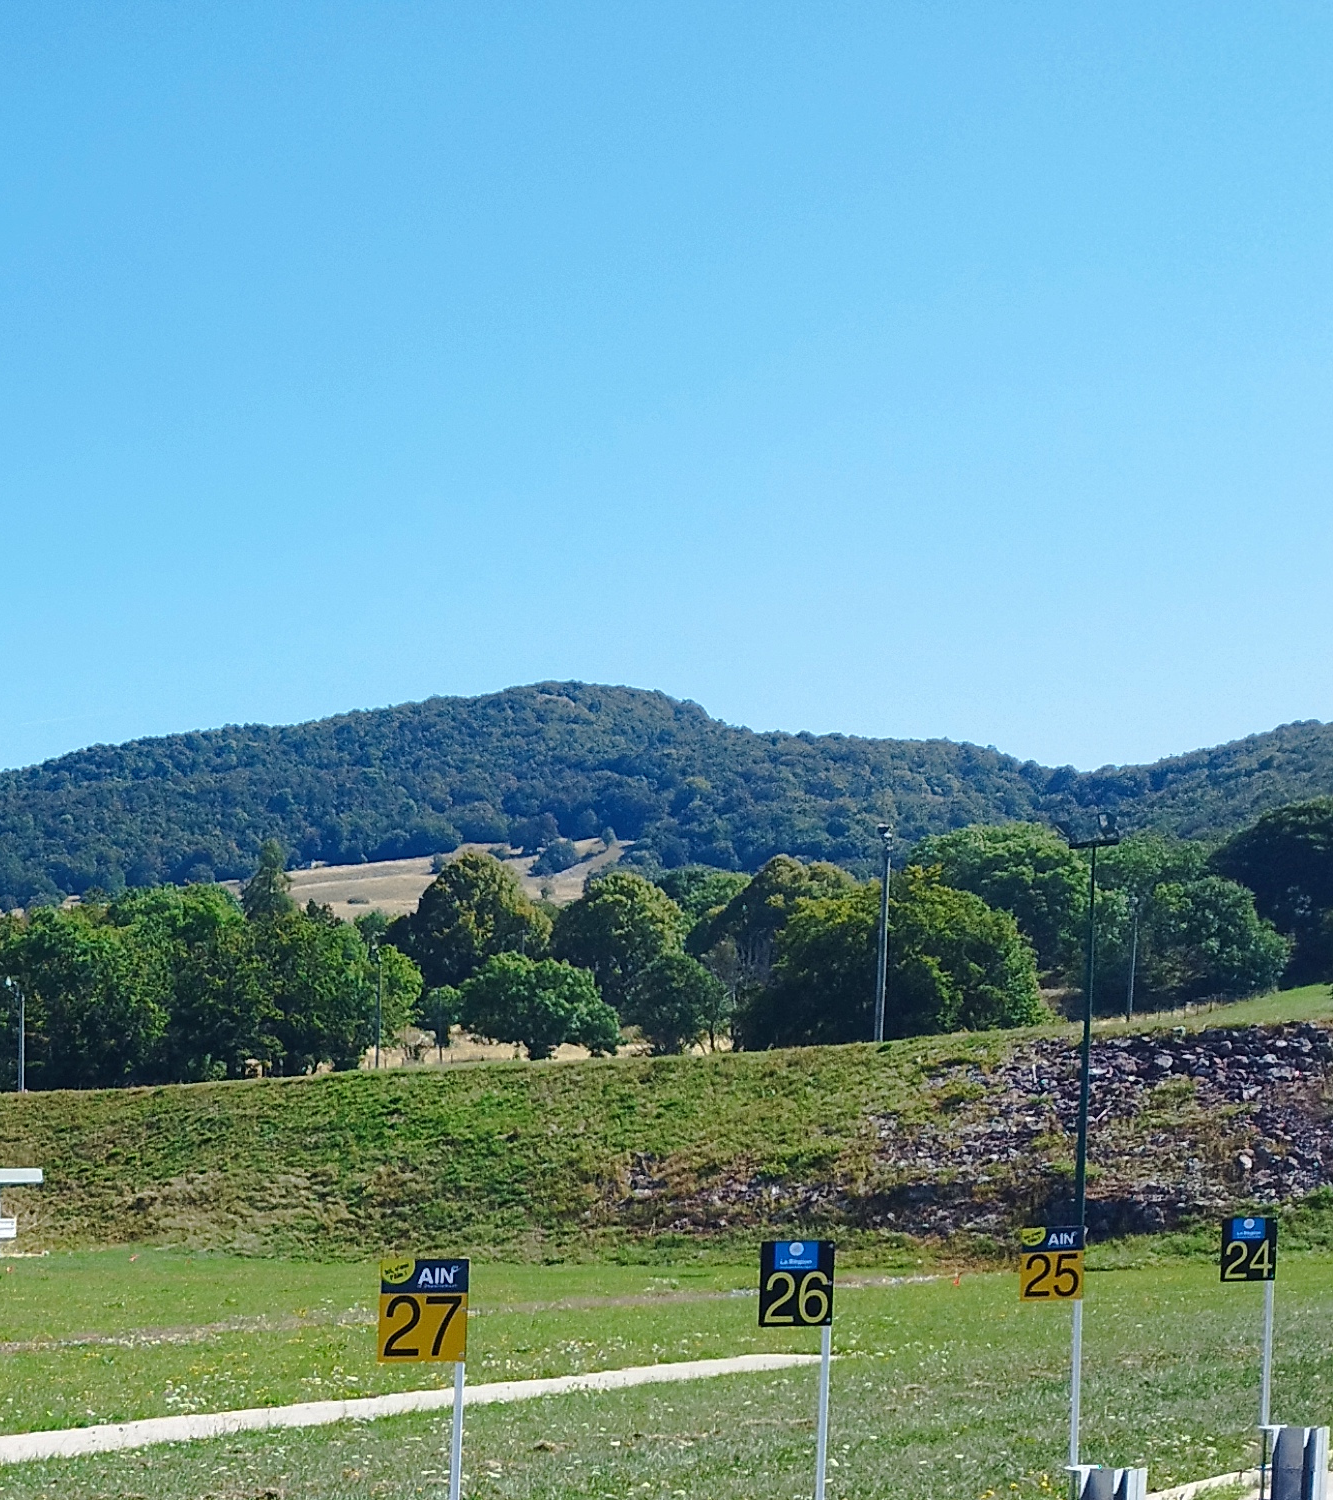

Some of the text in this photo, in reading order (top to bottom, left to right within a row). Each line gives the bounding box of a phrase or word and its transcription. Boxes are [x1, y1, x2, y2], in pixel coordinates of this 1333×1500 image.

[1048, 1232, 1073, 1246] AIN
[1224, 1238, 1273, 1279] 24
[418, 1267, 454, 1286] AIN
[1024, 1253, 1079, 1297] 25
[764, 1271, 829, 1323] 26
[383, 1295, 462, 1356] 27
